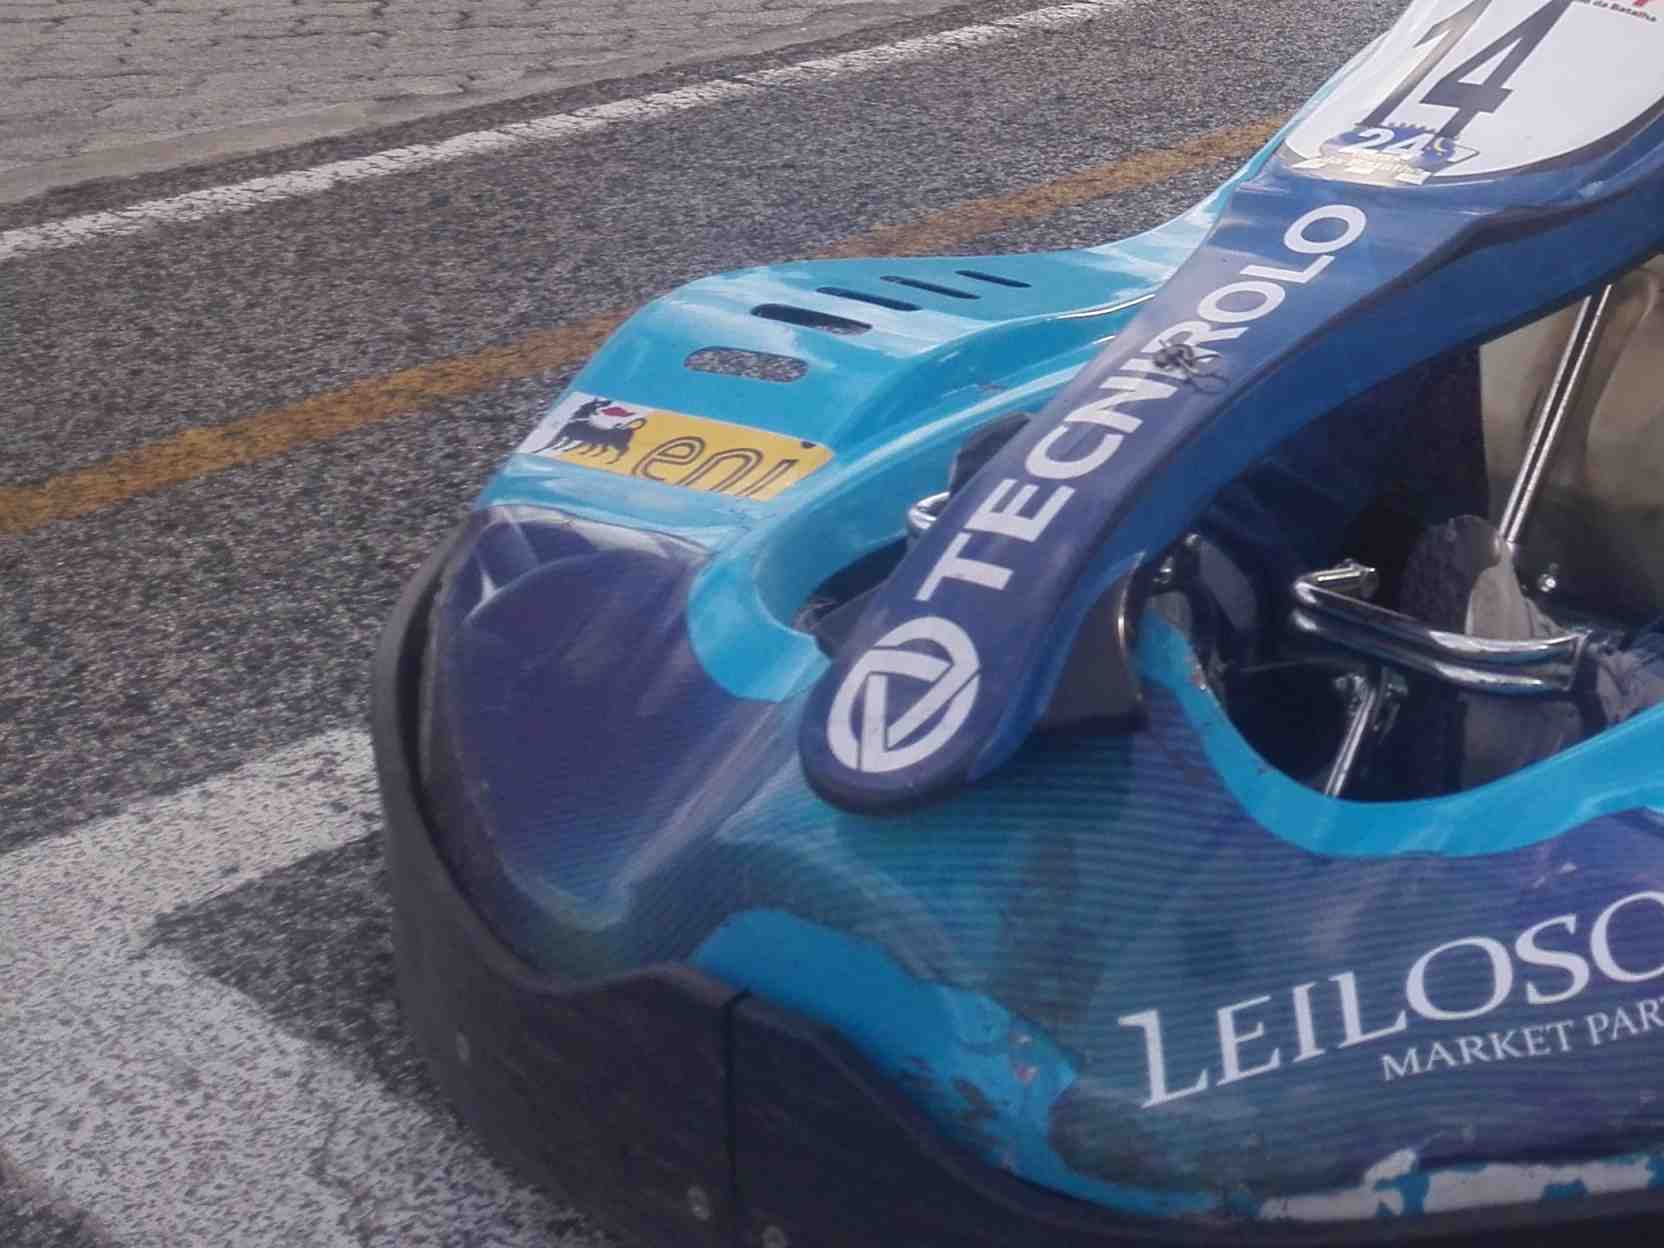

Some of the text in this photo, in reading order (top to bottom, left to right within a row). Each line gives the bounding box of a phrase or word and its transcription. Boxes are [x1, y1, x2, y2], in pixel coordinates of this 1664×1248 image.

[916, 204, 1366, 602] TECNIROLO
[632, 435, 816, 496] eni
[1380, 1018, 1574, 1083] MARKET
